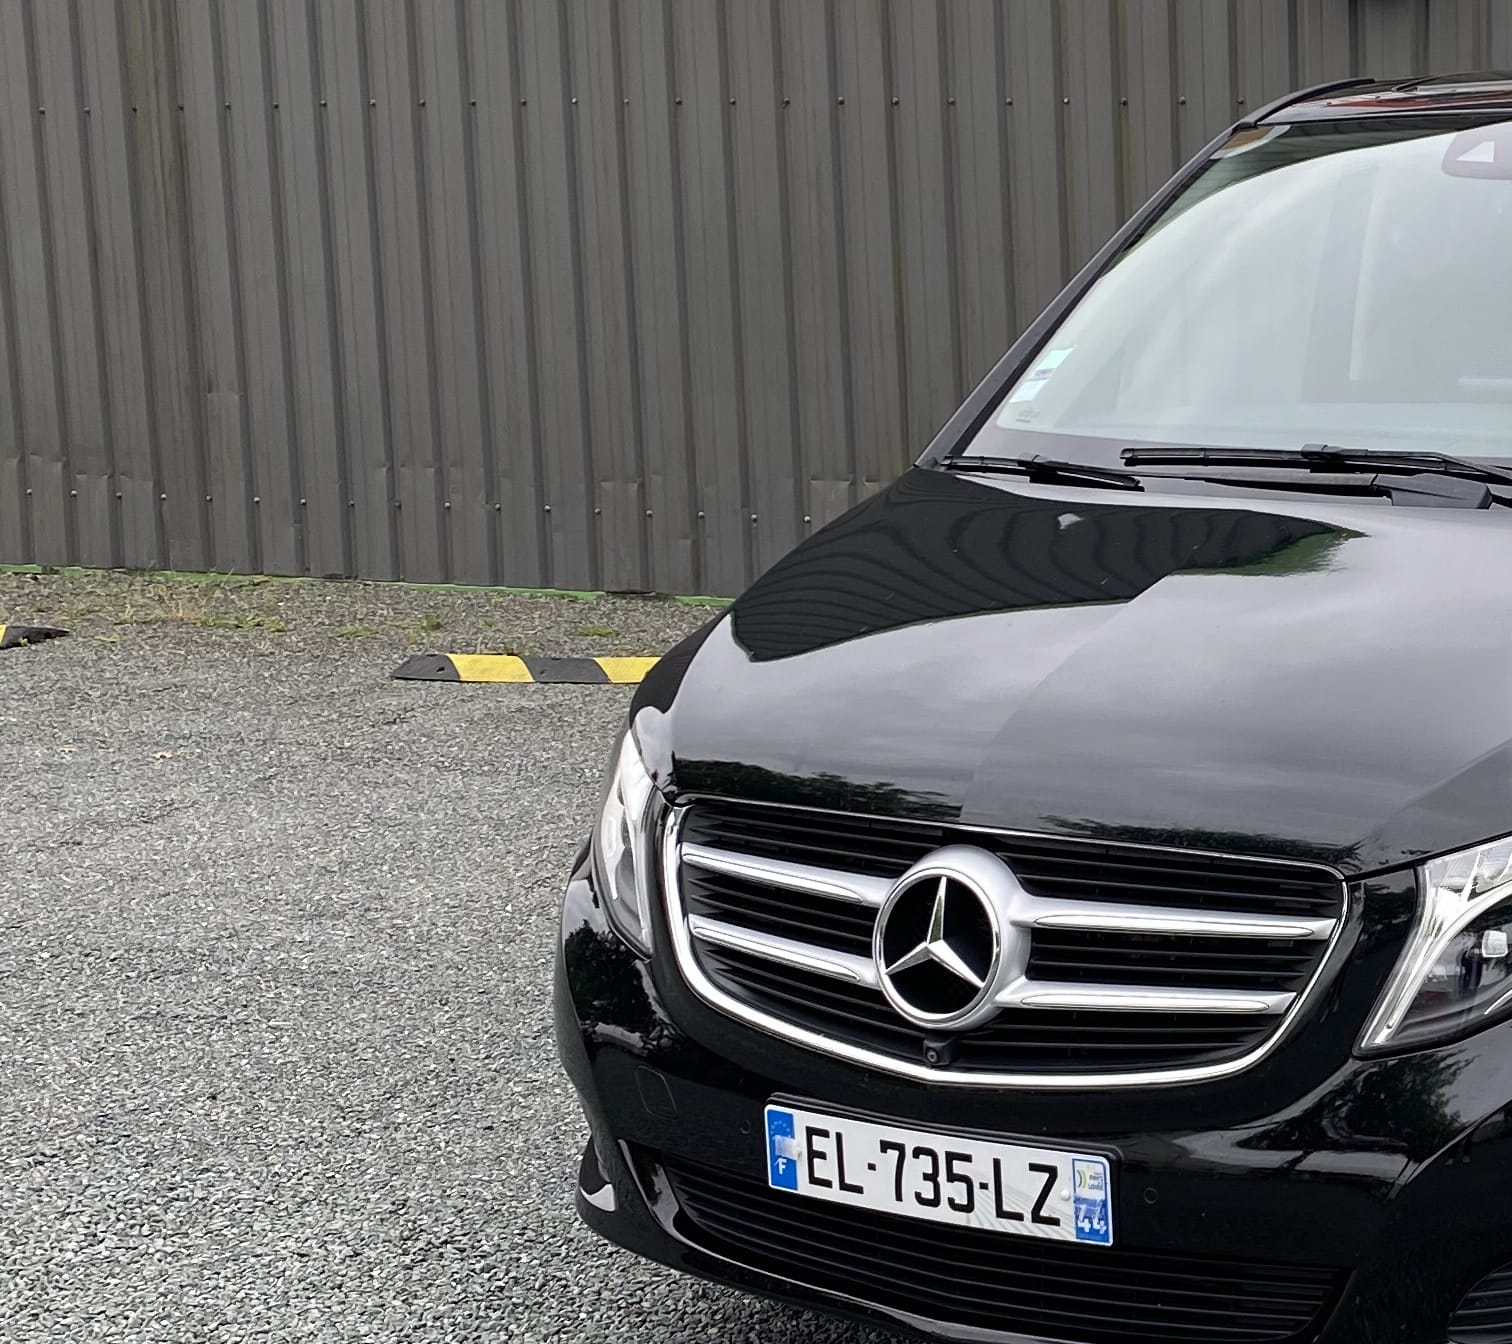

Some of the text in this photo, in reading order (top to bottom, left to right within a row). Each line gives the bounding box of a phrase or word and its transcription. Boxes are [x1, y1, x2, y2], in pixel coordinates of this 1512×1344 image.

[778, 1158, 788, 1175] F
[805, 1125, 1061, 1227] EL-735-LZ
[1076, 1199, 1107, 1235] 44
